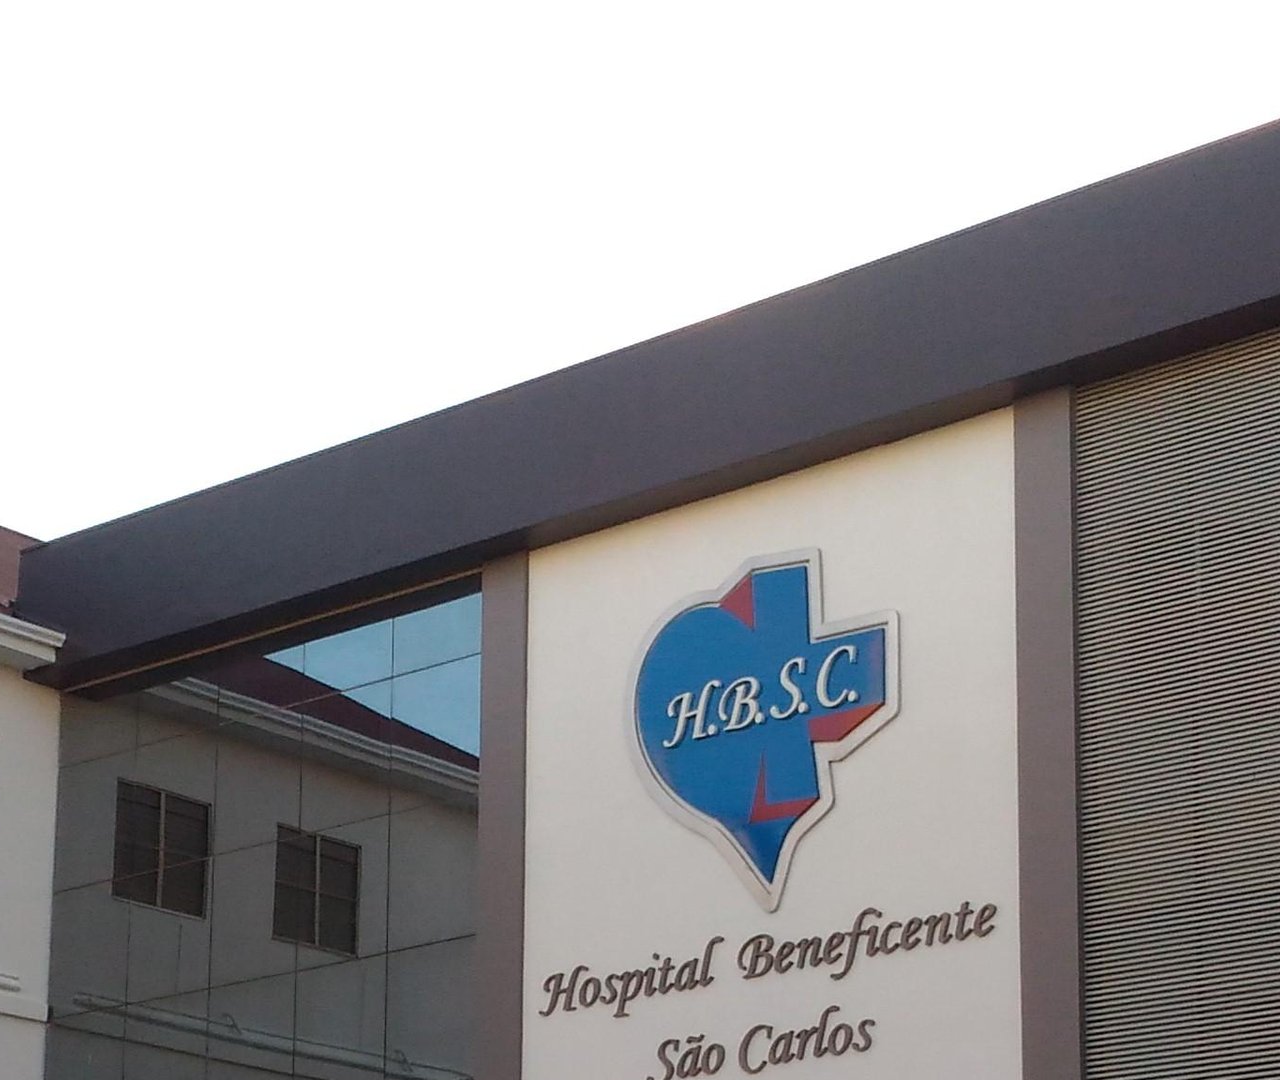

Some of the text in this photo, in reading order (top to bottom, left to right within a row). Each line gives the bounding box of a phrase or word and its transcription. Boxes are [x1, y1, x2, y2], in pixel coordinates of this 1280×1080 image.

[539, 900, 997, 1018] Hospital Beneficente
[737, 1005, 876, 1074] Carlos
